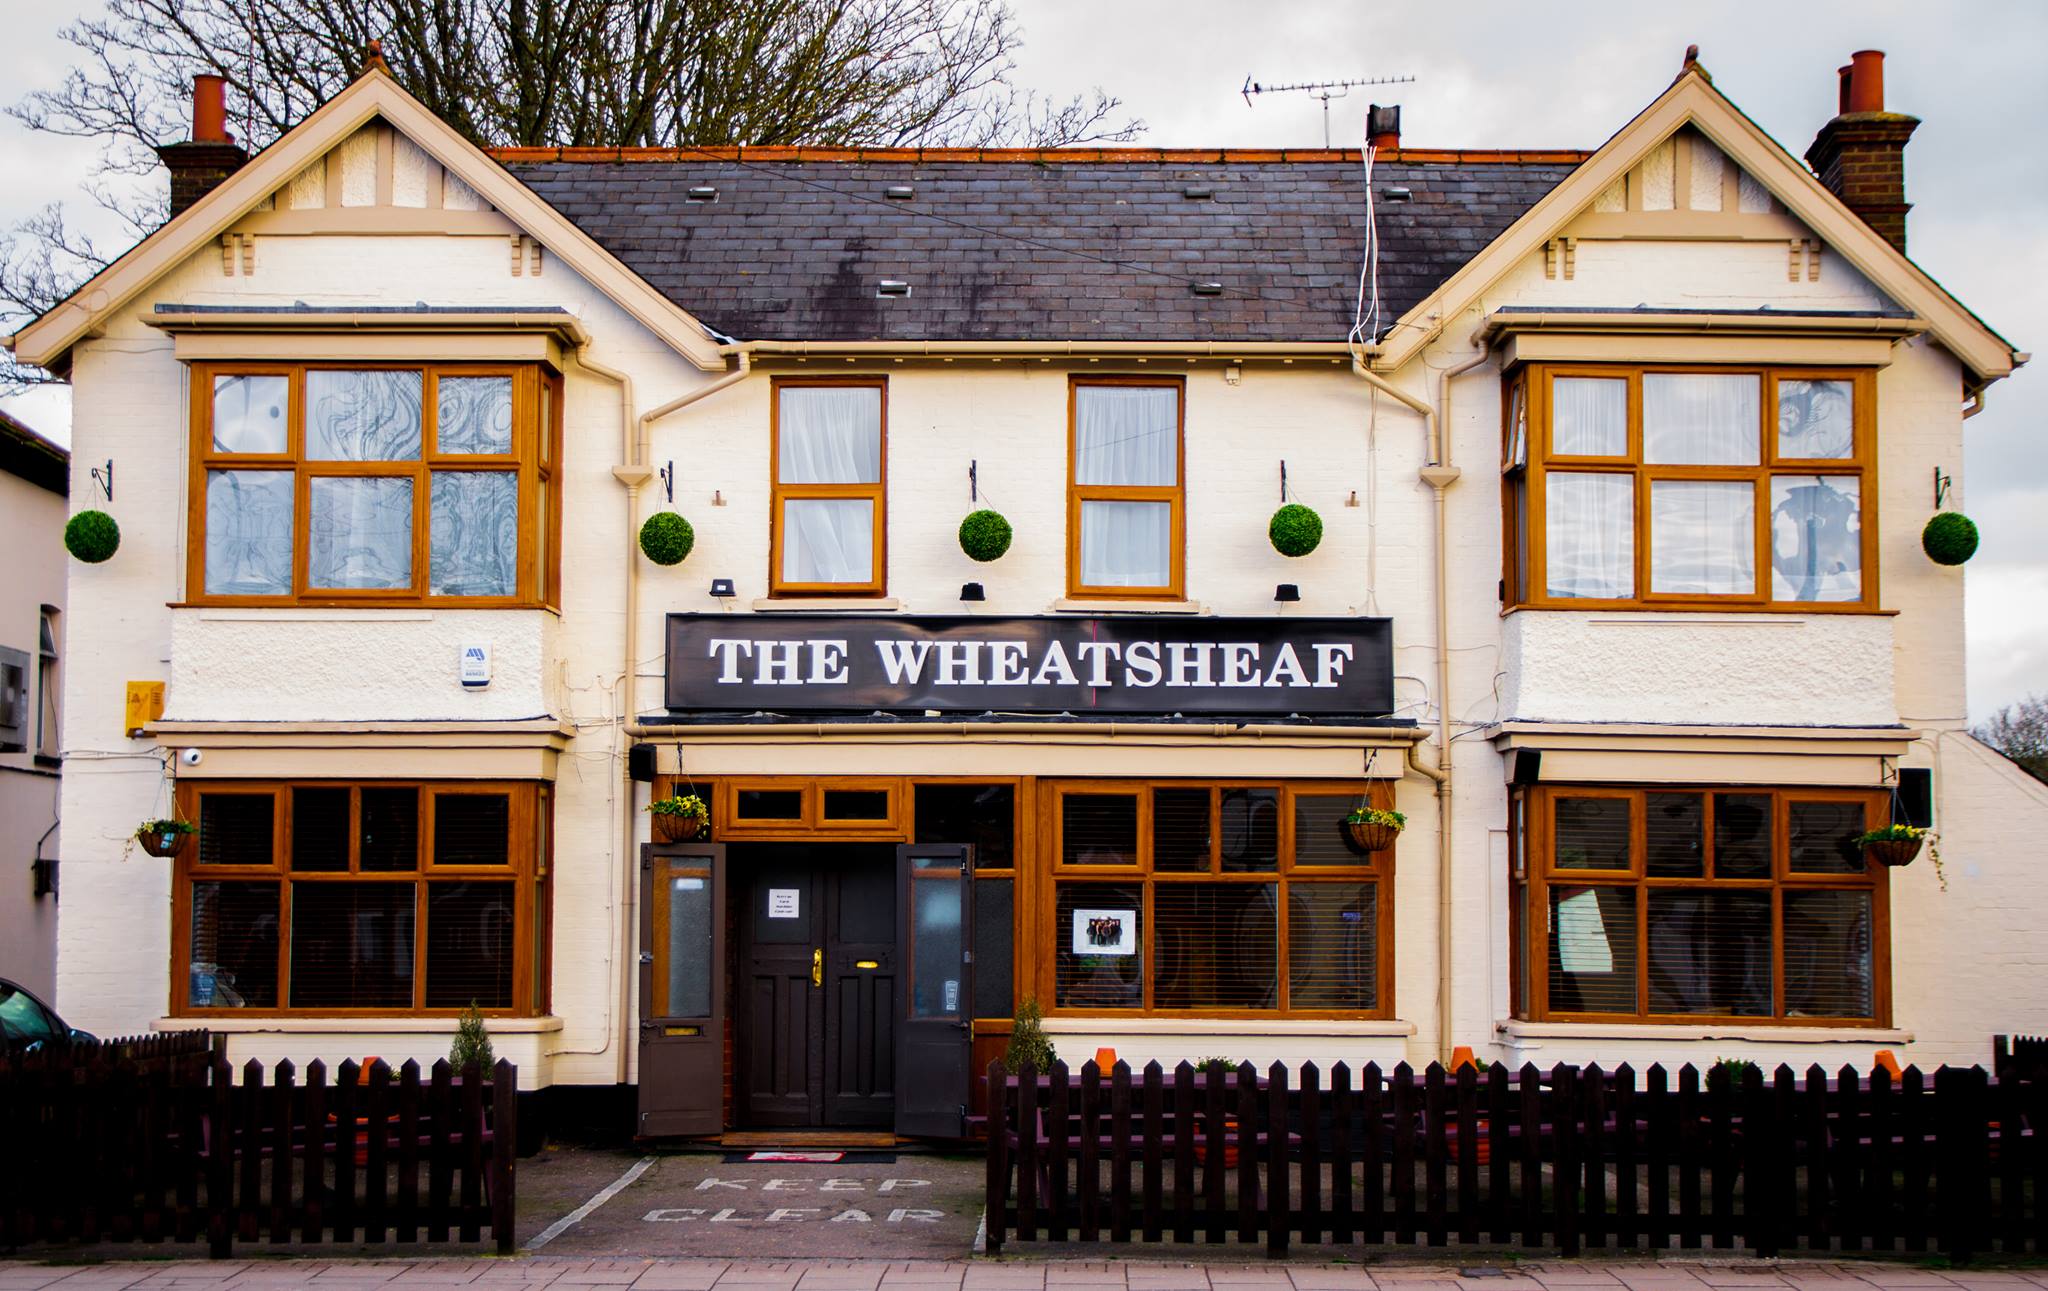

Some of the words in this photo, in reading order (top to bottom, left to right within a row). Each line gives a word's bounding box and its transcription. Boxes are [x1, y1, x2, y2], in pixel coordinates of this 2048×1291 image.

[708, 639, 849, 686] THE
[875, 640, 1354, 688] WHEATSHEAF
[694, 1178, 933, 1192] KEEP
[641, 1207, 947, 1223] CLEAR
